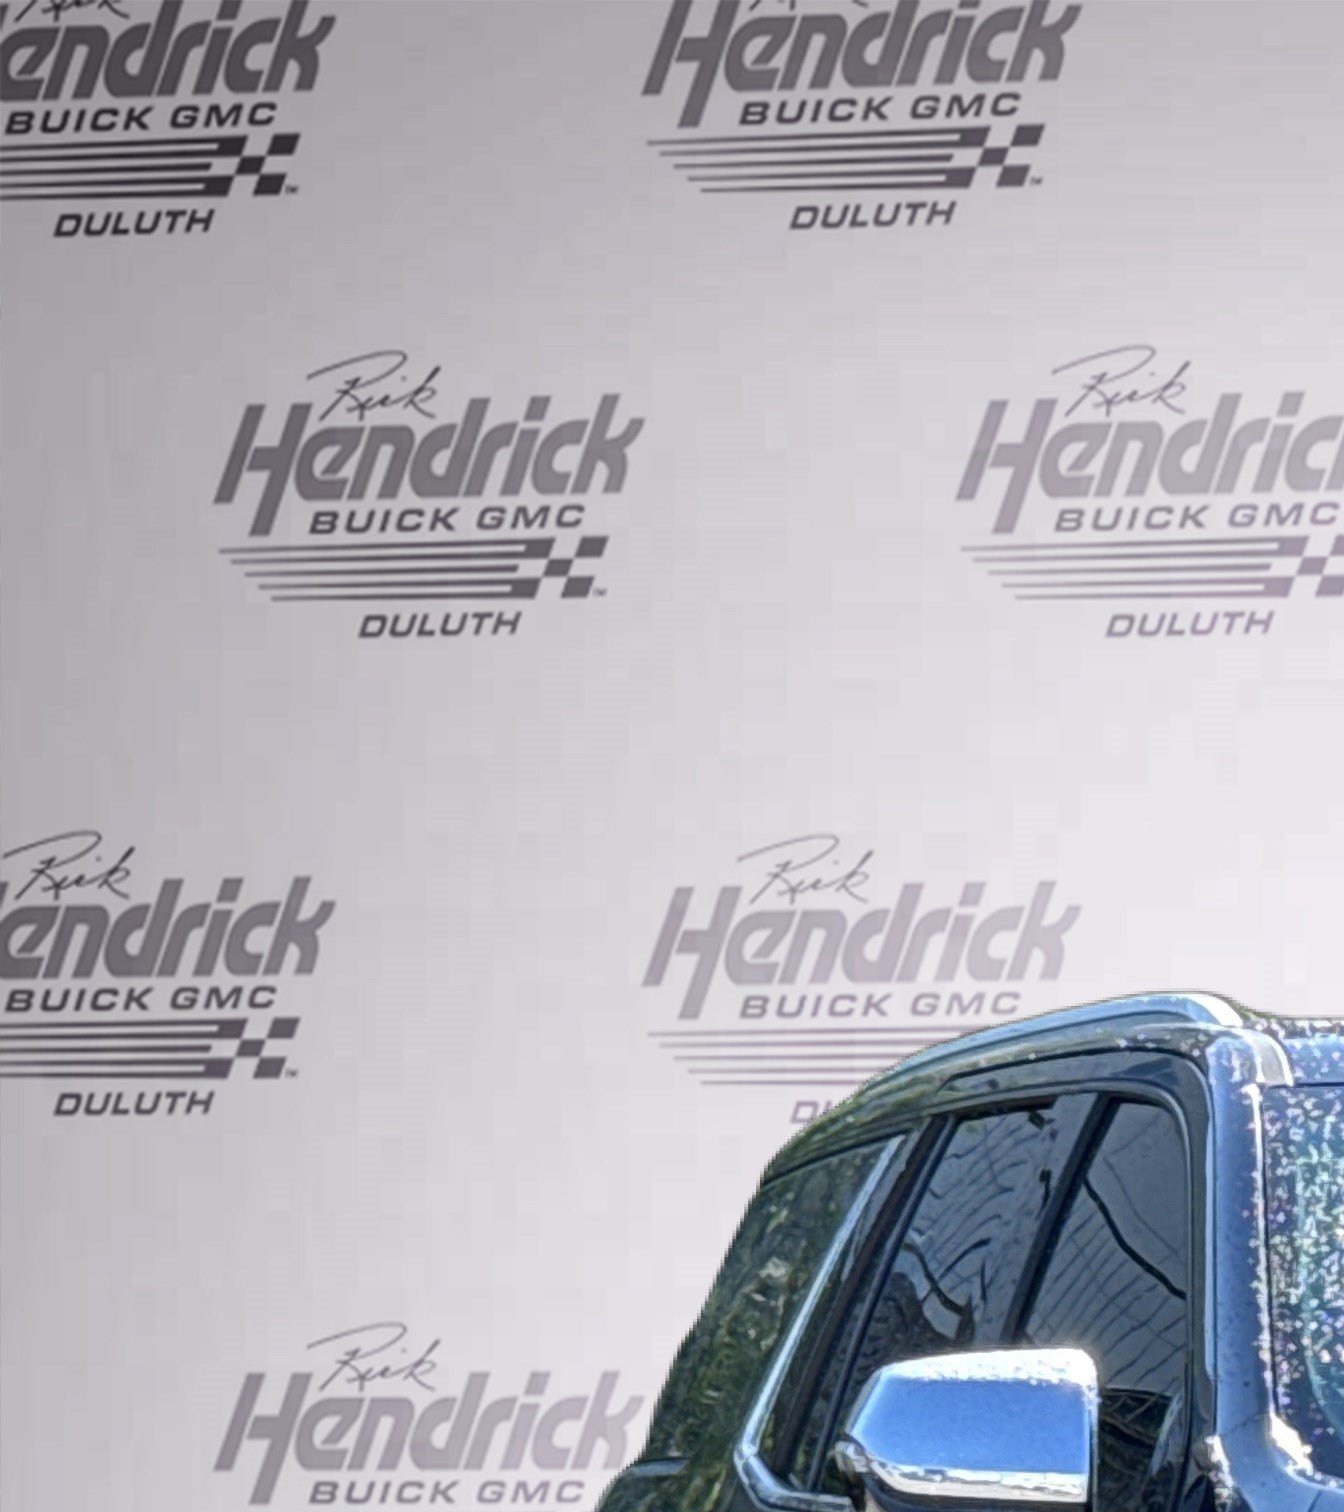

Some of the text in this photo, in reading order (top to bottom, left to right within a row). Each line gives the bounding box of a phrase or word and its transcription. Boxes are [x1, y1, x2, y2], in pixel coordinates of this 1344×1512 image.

[0, 0, 336, 101] endrick
[641, 0, 1083, 128] Hendrick
[5, 102, 278, 135] BUICK GMC
[738, 92, 1022, 125] BUICK GMC
[53, 208, 215, 238] DULUTH
[789, 201, 956, 230] DULUTH
[213, 393, 646, 538] Hendrick
[308, 504, 586, 536] BUICK GMC
[1053, 501, 1341, 533] BUICK GMC
[358, 611, 522, 639] DULUTH
[1105, 610, 1275, 638] DULUTH
[0, 876, 336, 981] endrick
[640, 879, 1082, 1021] Hendrick
[4, 985, 278, 1013] BUICK GMC
[738, 991, 1022, 1020] BUICK GMC
[53, 1090, 215, 1117] DULUTH
[212, 1370, 646, 1506] Hendrick
[308, 1480, 587, 1505] BUICK GMC
